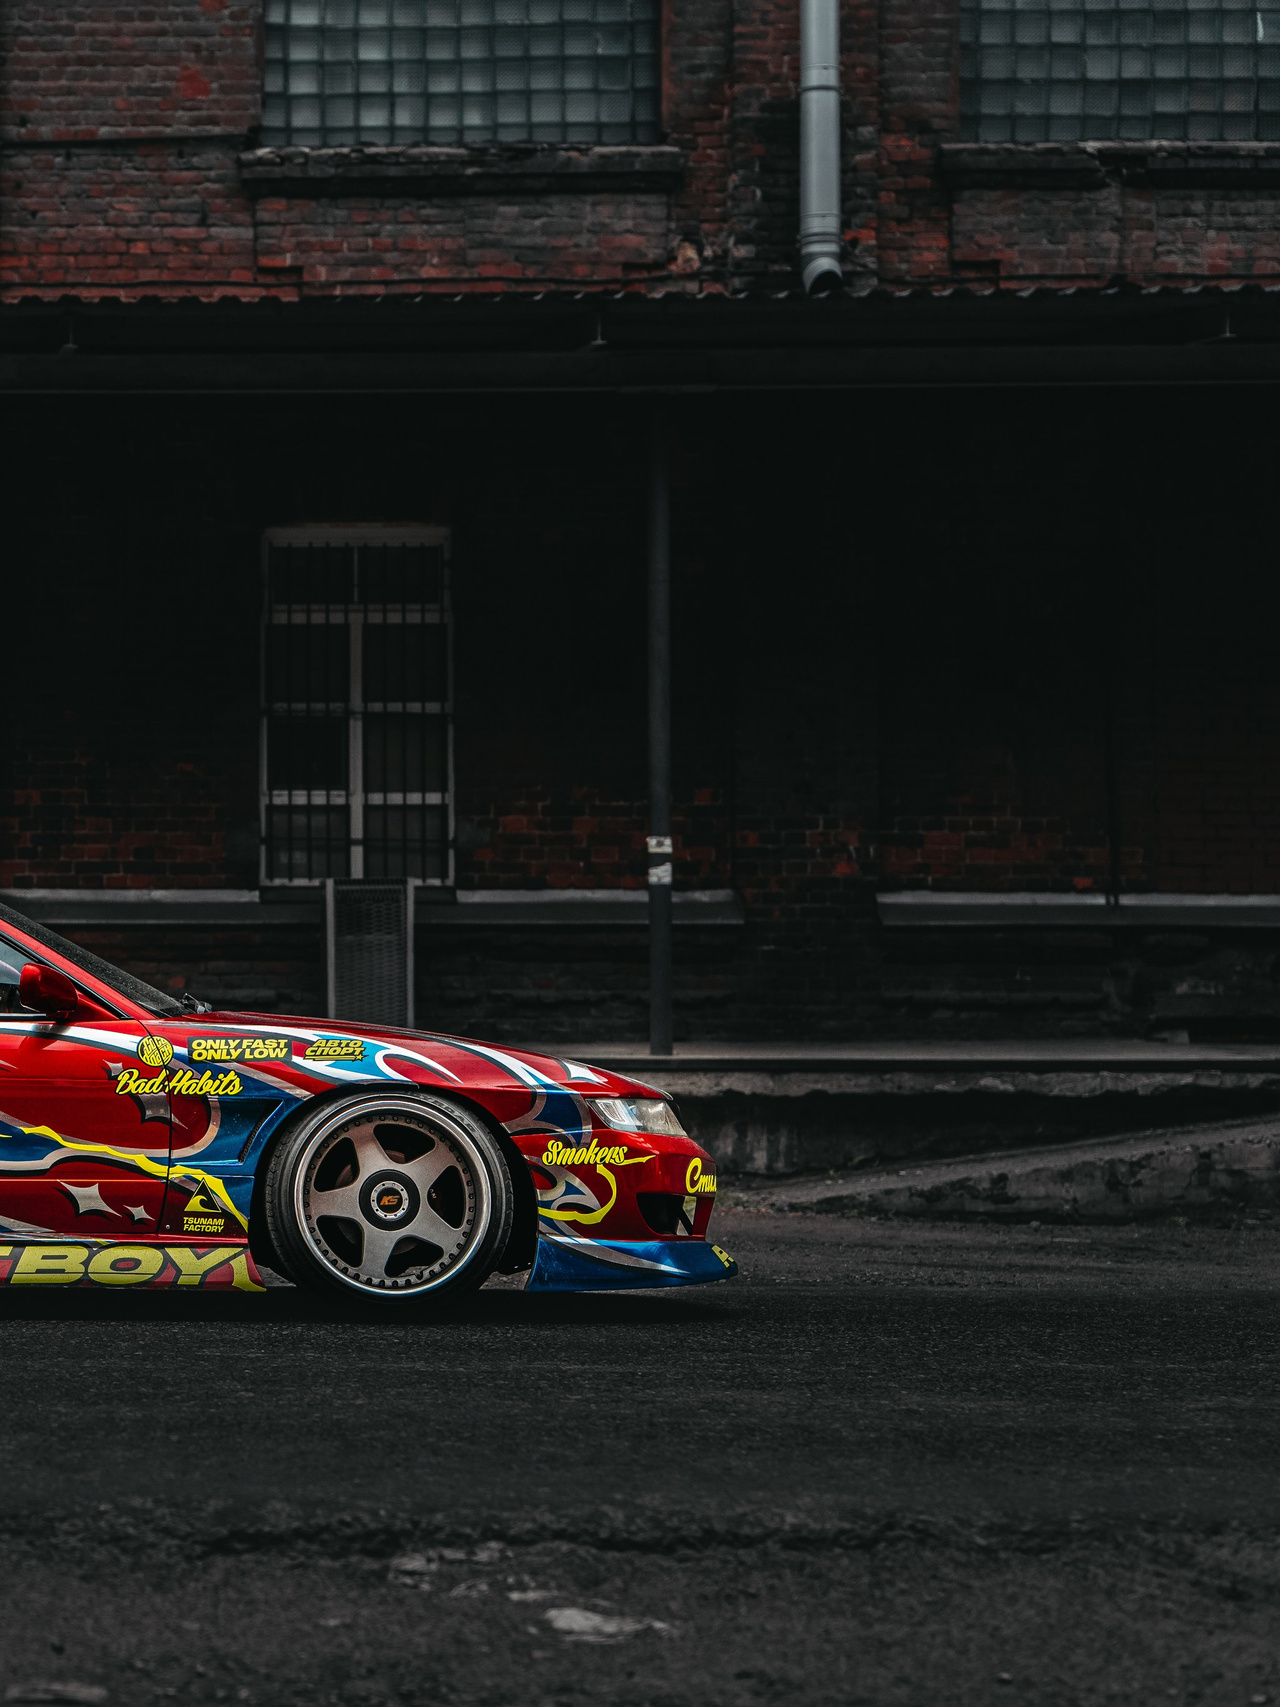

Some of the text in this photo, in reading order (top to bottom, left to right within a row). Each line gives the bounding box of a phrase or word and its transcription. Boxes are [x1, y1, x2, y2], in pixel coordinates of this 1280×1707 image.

[191, 1039, 288, 1050] ONLY FAST
[312, 1039, 363, 1048] АВТО
[192, 1048, 288, 1061] ONLY LOW
[305, 1047, 365, 1056] СПОРТ
[116, 1068, 170, 1095] Bad
[541, 1138, 628, 1166] Smokers
[183, 1217, 225, 1226] TSUNAMI
[183, 1224, 225, 1233] FACTORY
